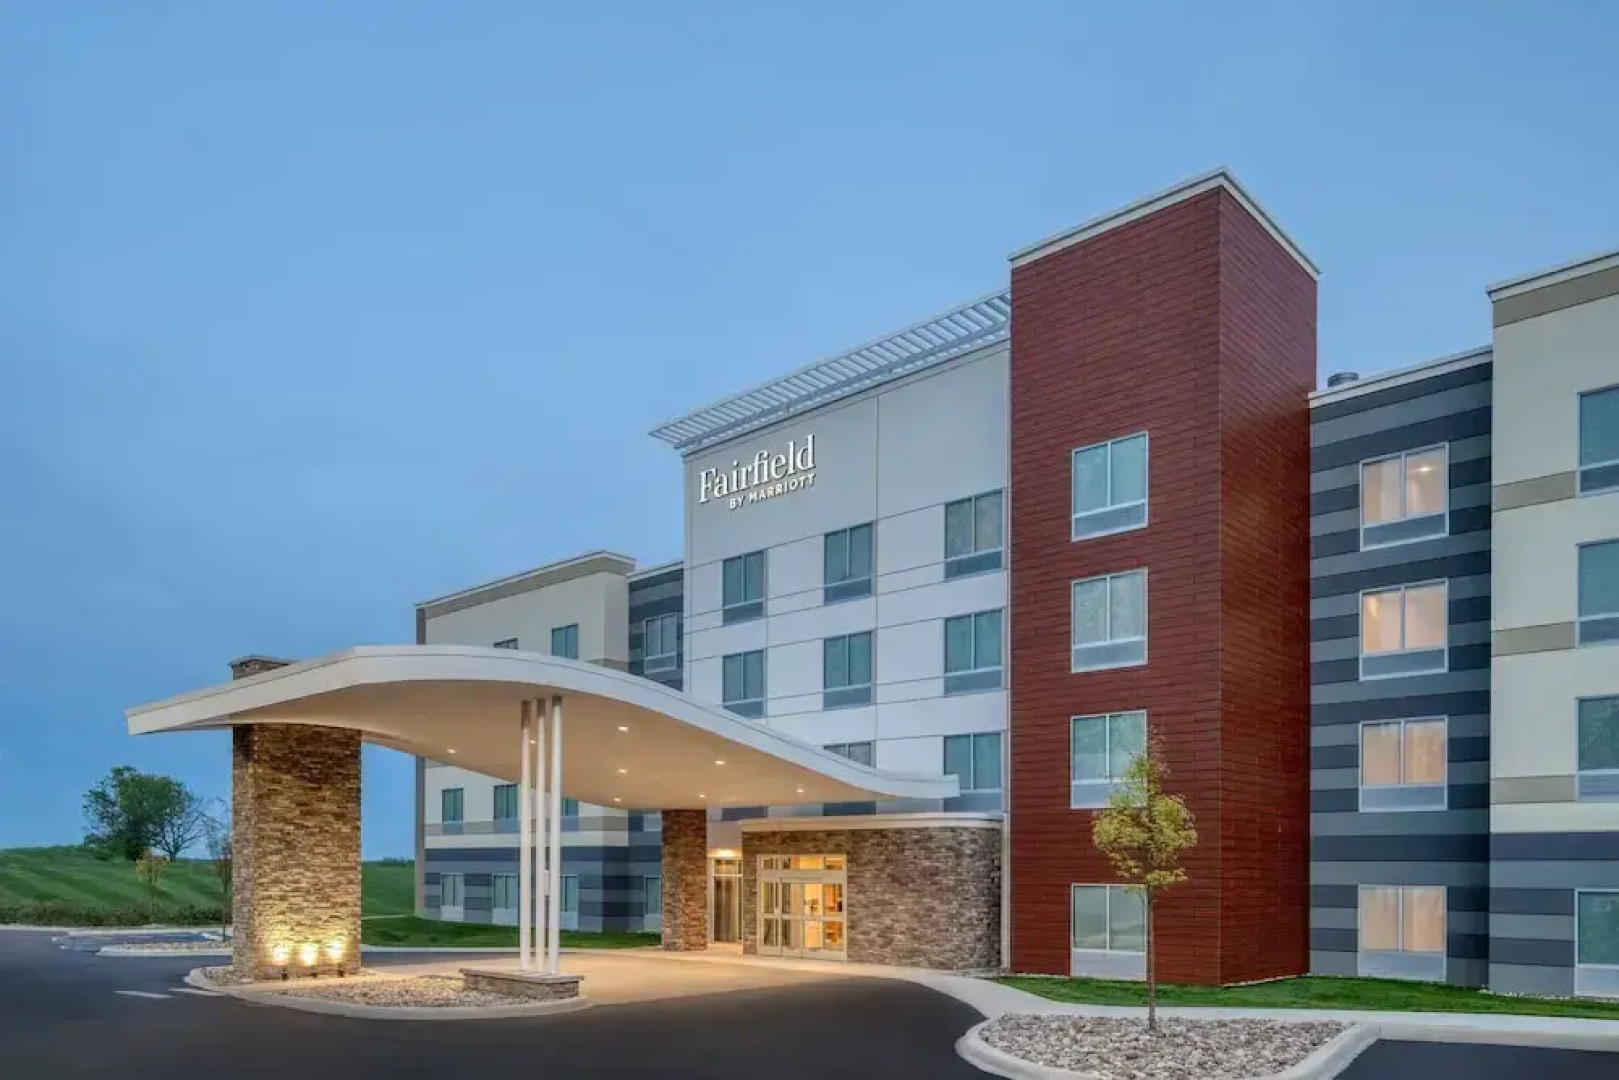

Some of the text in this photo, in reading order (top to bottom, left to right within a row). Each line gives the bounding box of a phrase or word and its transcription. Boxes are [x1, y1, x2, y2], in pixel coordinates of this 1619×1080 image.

[699, 434, 816, 503] Fairfield
[729, 473, 816, 510] BY MARRIOTT
